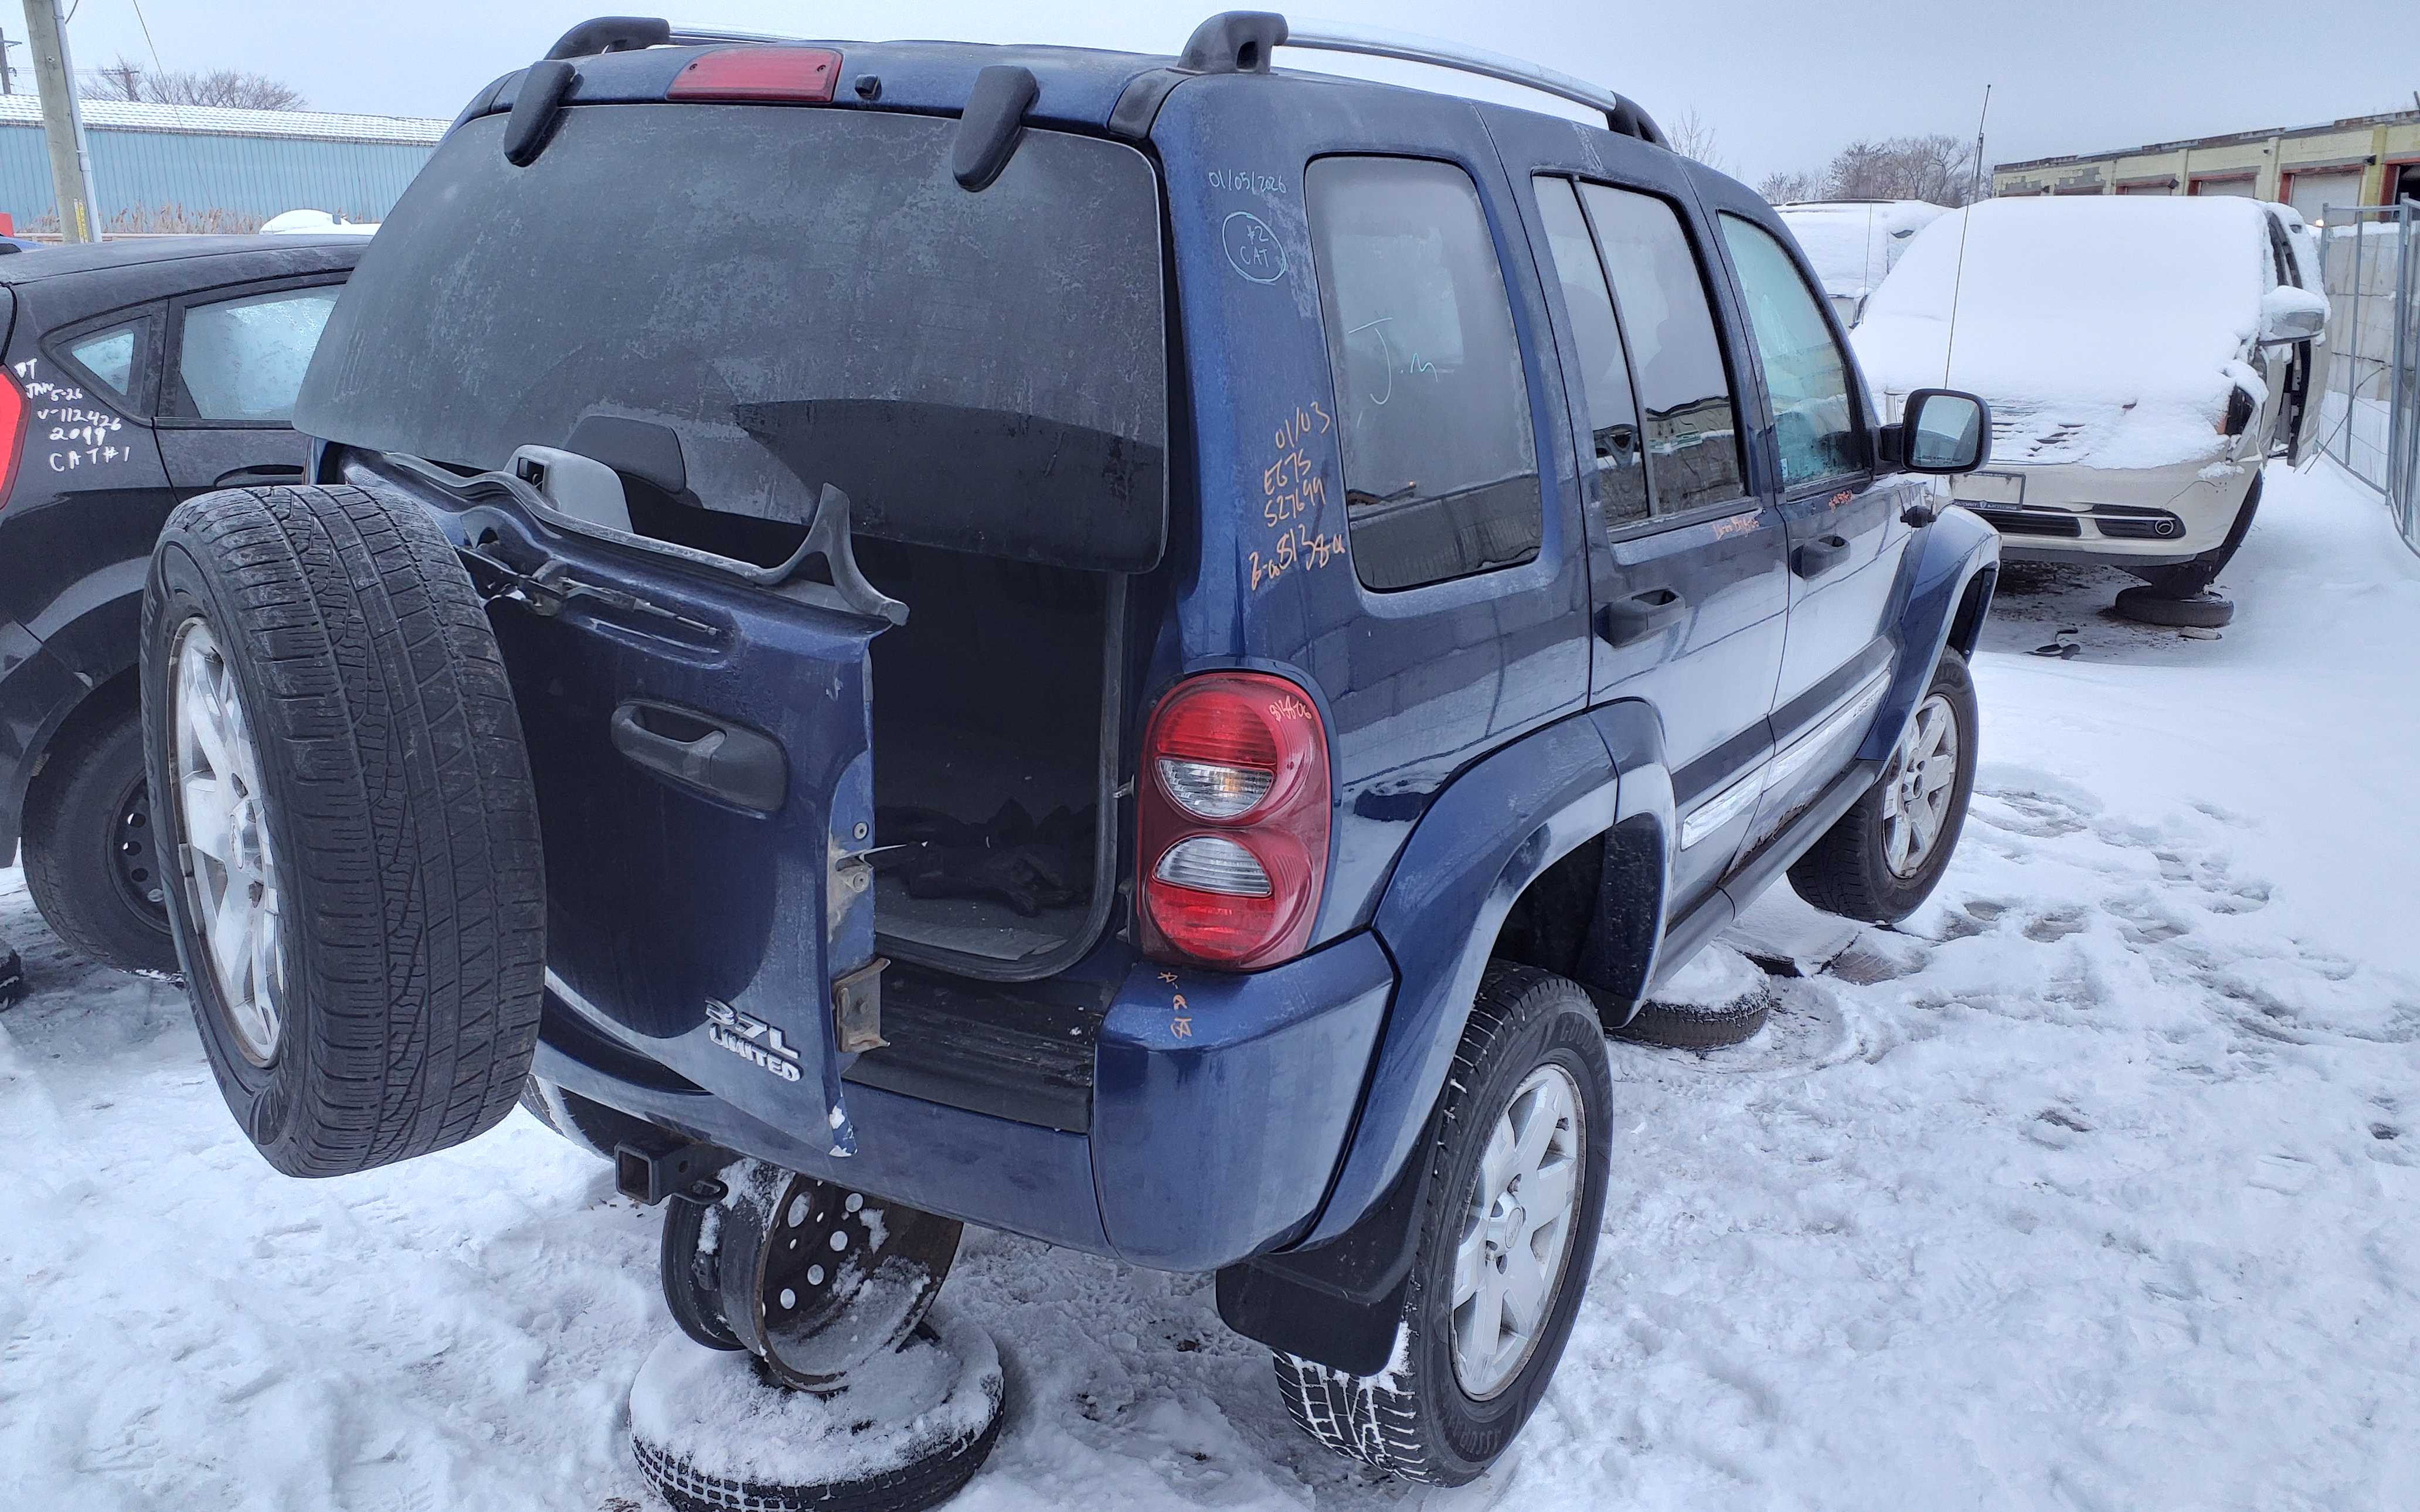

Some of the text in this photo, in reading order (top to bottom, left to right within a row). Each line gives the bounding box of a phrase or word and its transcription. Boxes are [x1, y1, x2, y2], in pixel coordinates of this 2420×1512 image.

[1240, 246, 1269, 268] CAT
[1275, 401, 1330, 449] 01/03
[709, 1023, 804, 1082] LIMITED
